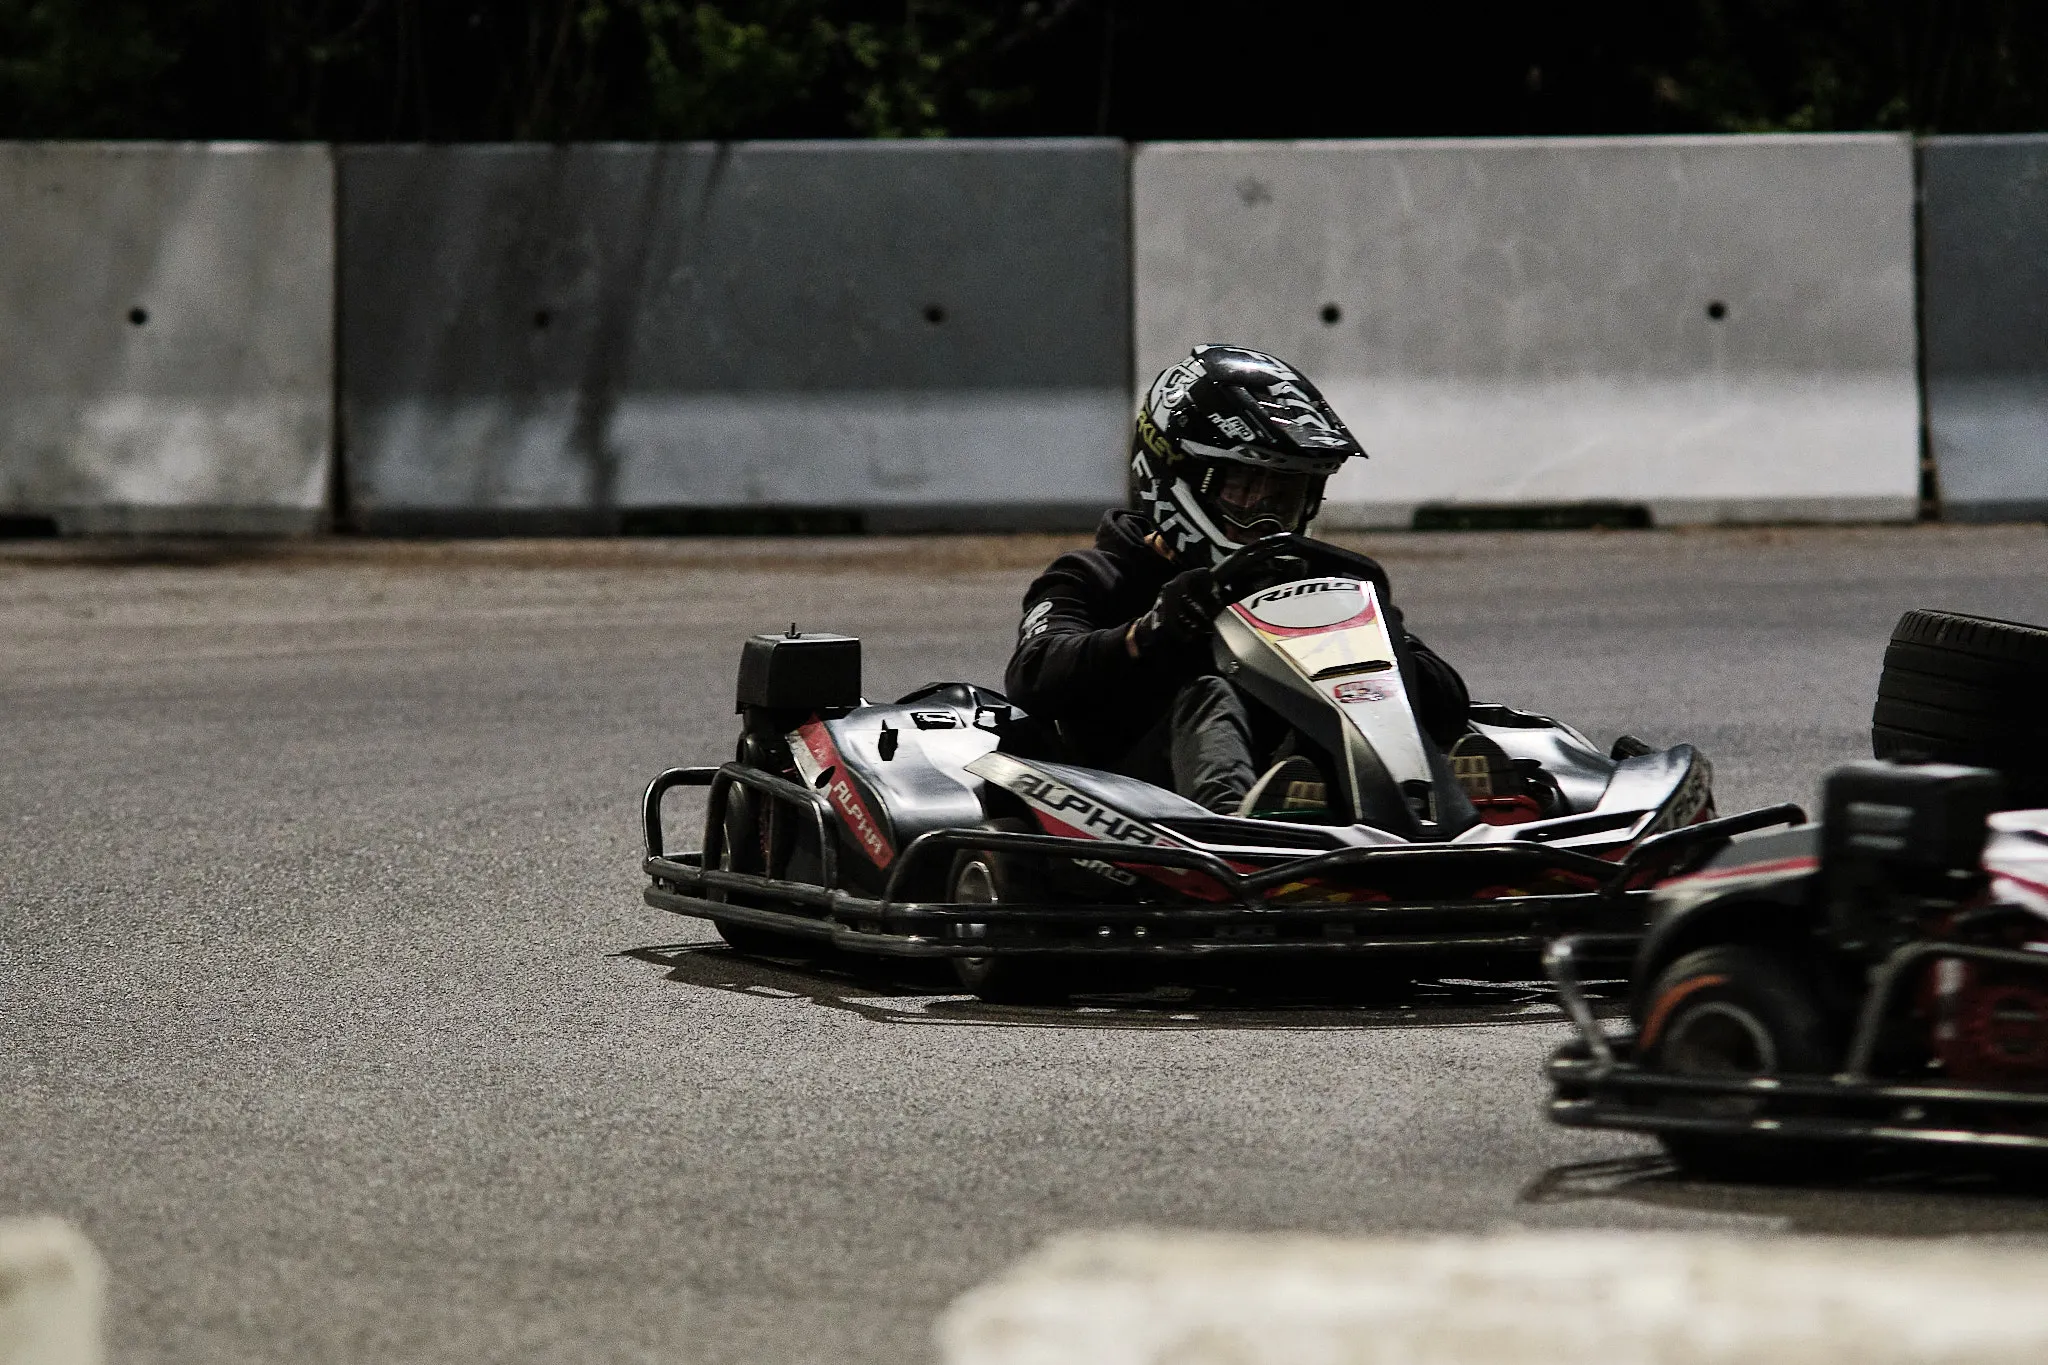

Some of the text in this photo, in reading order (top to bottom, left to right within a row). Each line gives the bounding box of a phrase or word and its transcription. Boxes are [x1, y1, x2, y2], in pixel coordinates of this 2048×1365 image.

[1137, 406, 1184, 466] AKLEY
[1131, 450, 1204, 553] FXR
[832, 781, 889, 855] ALPHA
